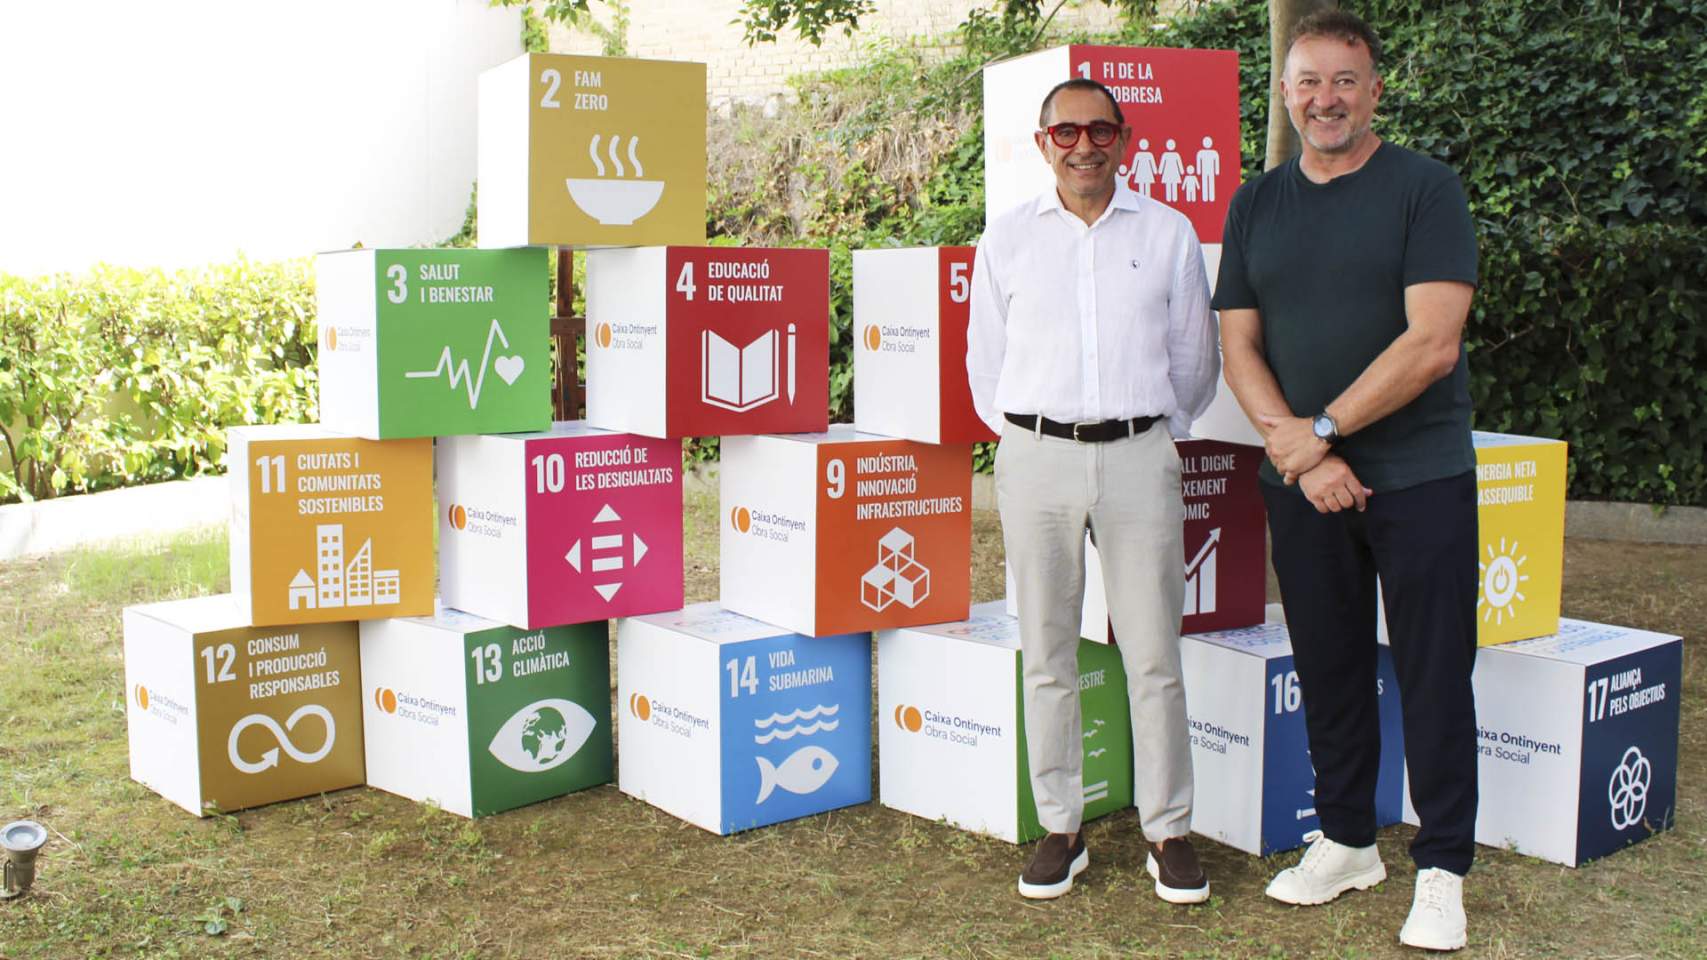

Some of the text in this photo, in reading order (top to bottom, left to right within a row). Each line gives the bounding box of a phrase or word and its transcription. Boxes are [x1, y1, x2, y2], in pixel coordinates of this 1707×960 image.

[574, 70, 601, 87] FAM
[1103, 62, 1153, 80] FI DE LA
[540, 69, 561, 108] 2
[574, 93, 608, 111] ZERO
[420, 263, 460, 281] SALUT
[708, 258, 770, 279] EDUCACIÓ
[387, 264, 408, 304] 3
[675, 261, 697, 301] 4
[949, 262, 969, 303] 5
[420, 286, 493, 303] I BENESTAR
[708, 284, 784, 304] DE QUALITAT
[297, 452, 360, 470] CIUTATS I
[575, 444, 648, 468] REDUCCIÓ DE
[857, 451, 919, 474] INDÚSTRIA,
[1201, 454, 1236, 473] DIGNE
[256, 455, 286, 494] 11
[531, 453, 566, 494] 10
[575, 467, 673, 491] LES DESIGUALTATS
[826, 458, 845, 499] 9
[1476, 460, 1537, 481] NERGIA NETA
[298, 474, 381, 493] COMUNITATS
[856, 473, 917, 497] INNOVACIÓ
[1183, 478, 1227, 497] XEMENT
[1478, 484, 1534, 506] ASSEQUIBLE
[298, 496, 384, 515] SOSTENIBLES
[856, 496, 963, 521] INFRAESTRUCTURES
[247, 633, 300, 656] CONSUM
[512, 631, 546, 655] ACCIÓ
[201, 643, 237, 684] 12
[248, 647, 327, 678] I PRODUCCIÓ
[471, 643, 502, 685] 13
[513, 651, 570, 677] CLIMÀTICA
[768, 649, 795, 669] VIDA
[249, 670, 340, 700] RESPONSABLES
[726, 655, 759, 698] 14
[769, 665, 834, 692] SUBMARINA
[1080, 669, 1105, 690] ESTRE
[1610, 667, 1642, 693] ALIANÇA
[1271, 670, 1301, 715] 16
[1588, 677, 1609, 723] 17
[1609, 683, 1666, 717] PELS OBJECTIUS
[925, 710, 1001, 738] Caixa Ontinyent
[925, 724, 978, 747] Obra Social
[1189, 715, 1250, 747] ixa Ontinyent
[1200, 736, 1227, 754] Social
[1476, 726, 1561, 755] ixa Ontinyent
[1495, 746, 1531, 765] Social
